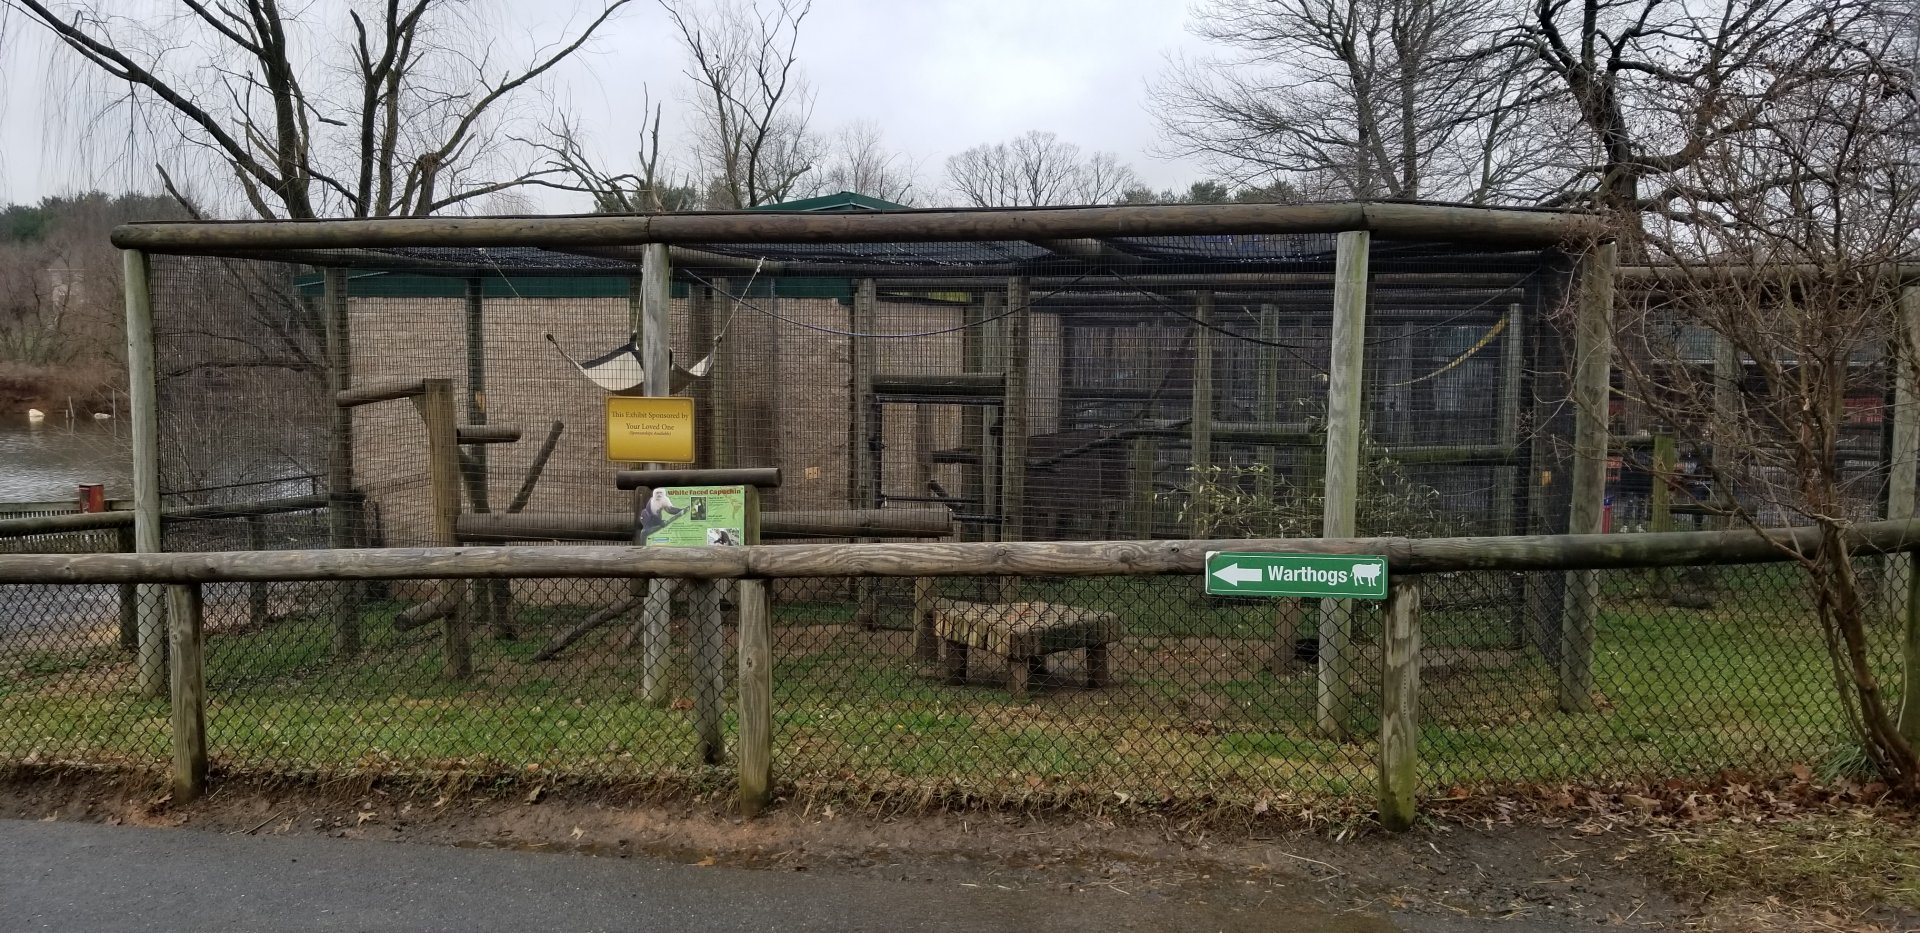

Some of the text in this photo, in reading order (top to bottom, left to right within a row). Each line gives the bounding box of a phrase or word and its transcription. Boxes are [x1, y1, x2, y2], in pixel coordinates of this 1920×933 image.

[648, 412, 680, 420] Sponsored
[681, 412, 689, 421] by
[709, 488, 741, 496] Capuchin
[1267, 565, 1348, 586] Warthogs
